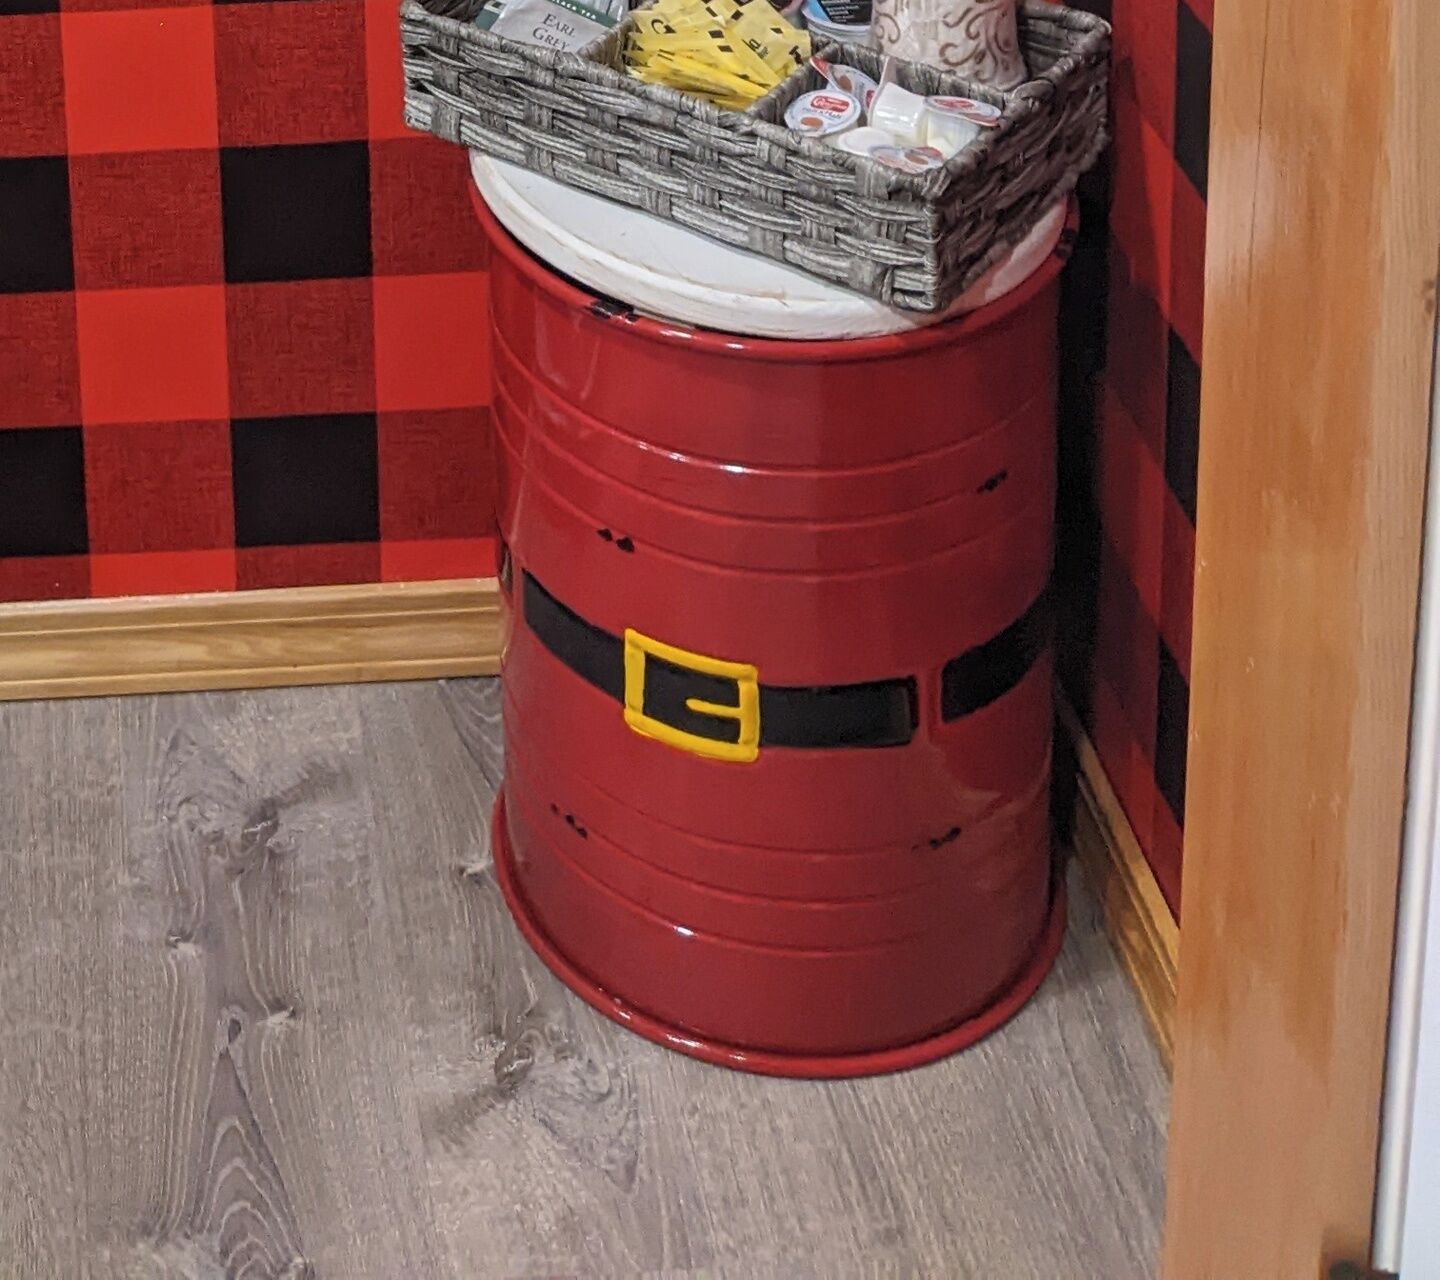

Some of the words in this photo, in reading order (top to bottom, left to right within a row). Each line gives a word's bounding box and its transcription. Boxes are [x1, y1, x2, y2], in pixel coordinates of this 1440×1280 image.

[542, 13, 576, 38] EARL
[581, 8, 596, 20] TEA
[532, 26, 571, 52] GREY
